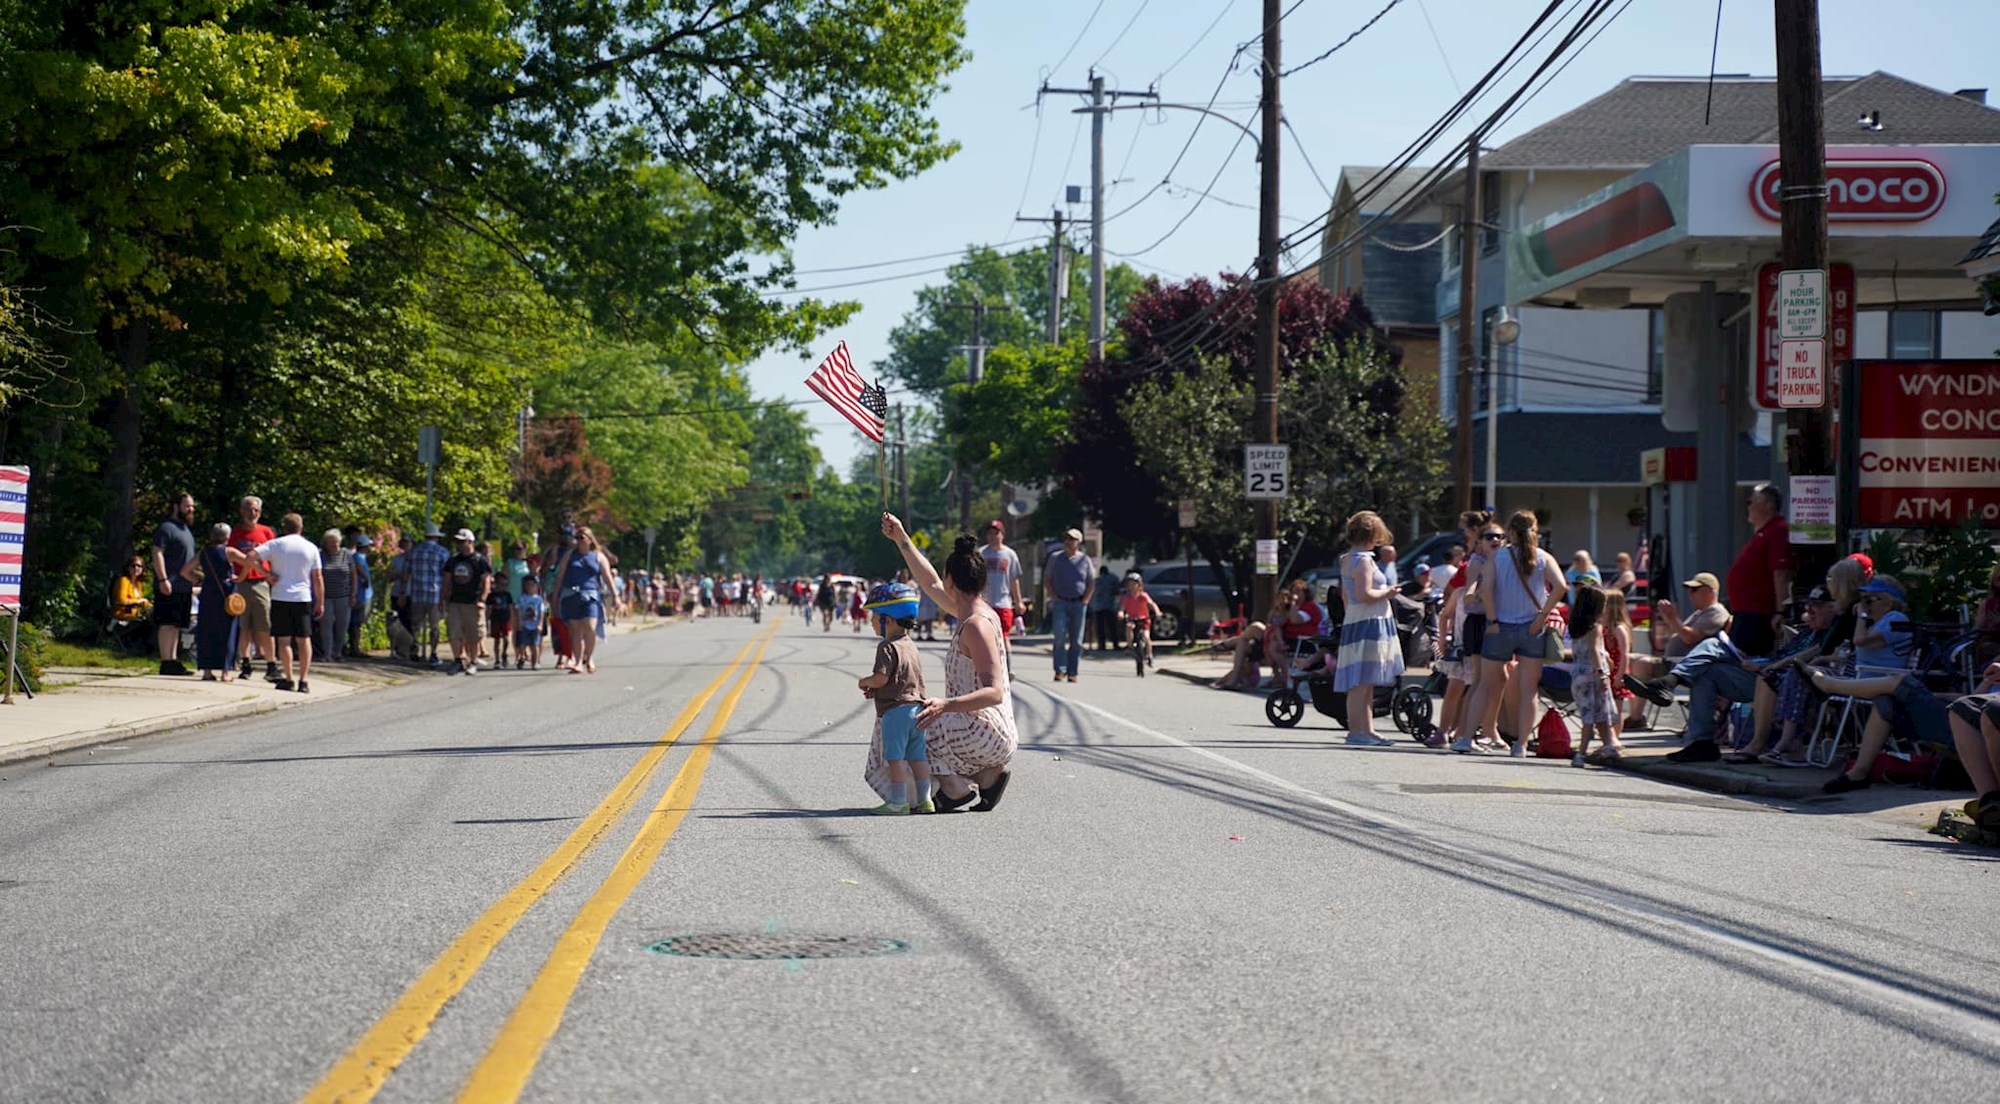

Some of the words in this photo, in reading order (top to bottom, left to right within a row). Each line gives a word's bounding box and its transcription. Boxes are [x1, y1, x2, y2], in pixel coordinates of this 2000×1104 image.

[1770, 177, 1929, 203] noco
[1790, 287, 1814, 298] HOUR
[1783, 297, 1821, 307] PARKING
[1795, 350, 1808, 363] NO
[1786, 366, 1817, 379] TRUCK
[1782, 383, 1821, 396] PARKING
[1249, 451, 1286, 460] SPEED
[1860, 451, 2000, 473] CONVENIEN
[1253, 462, 1281, 470] LIMIT
[1250, 473, 1285, 492] 25
[1894, 498, 1952, 520] ATM
